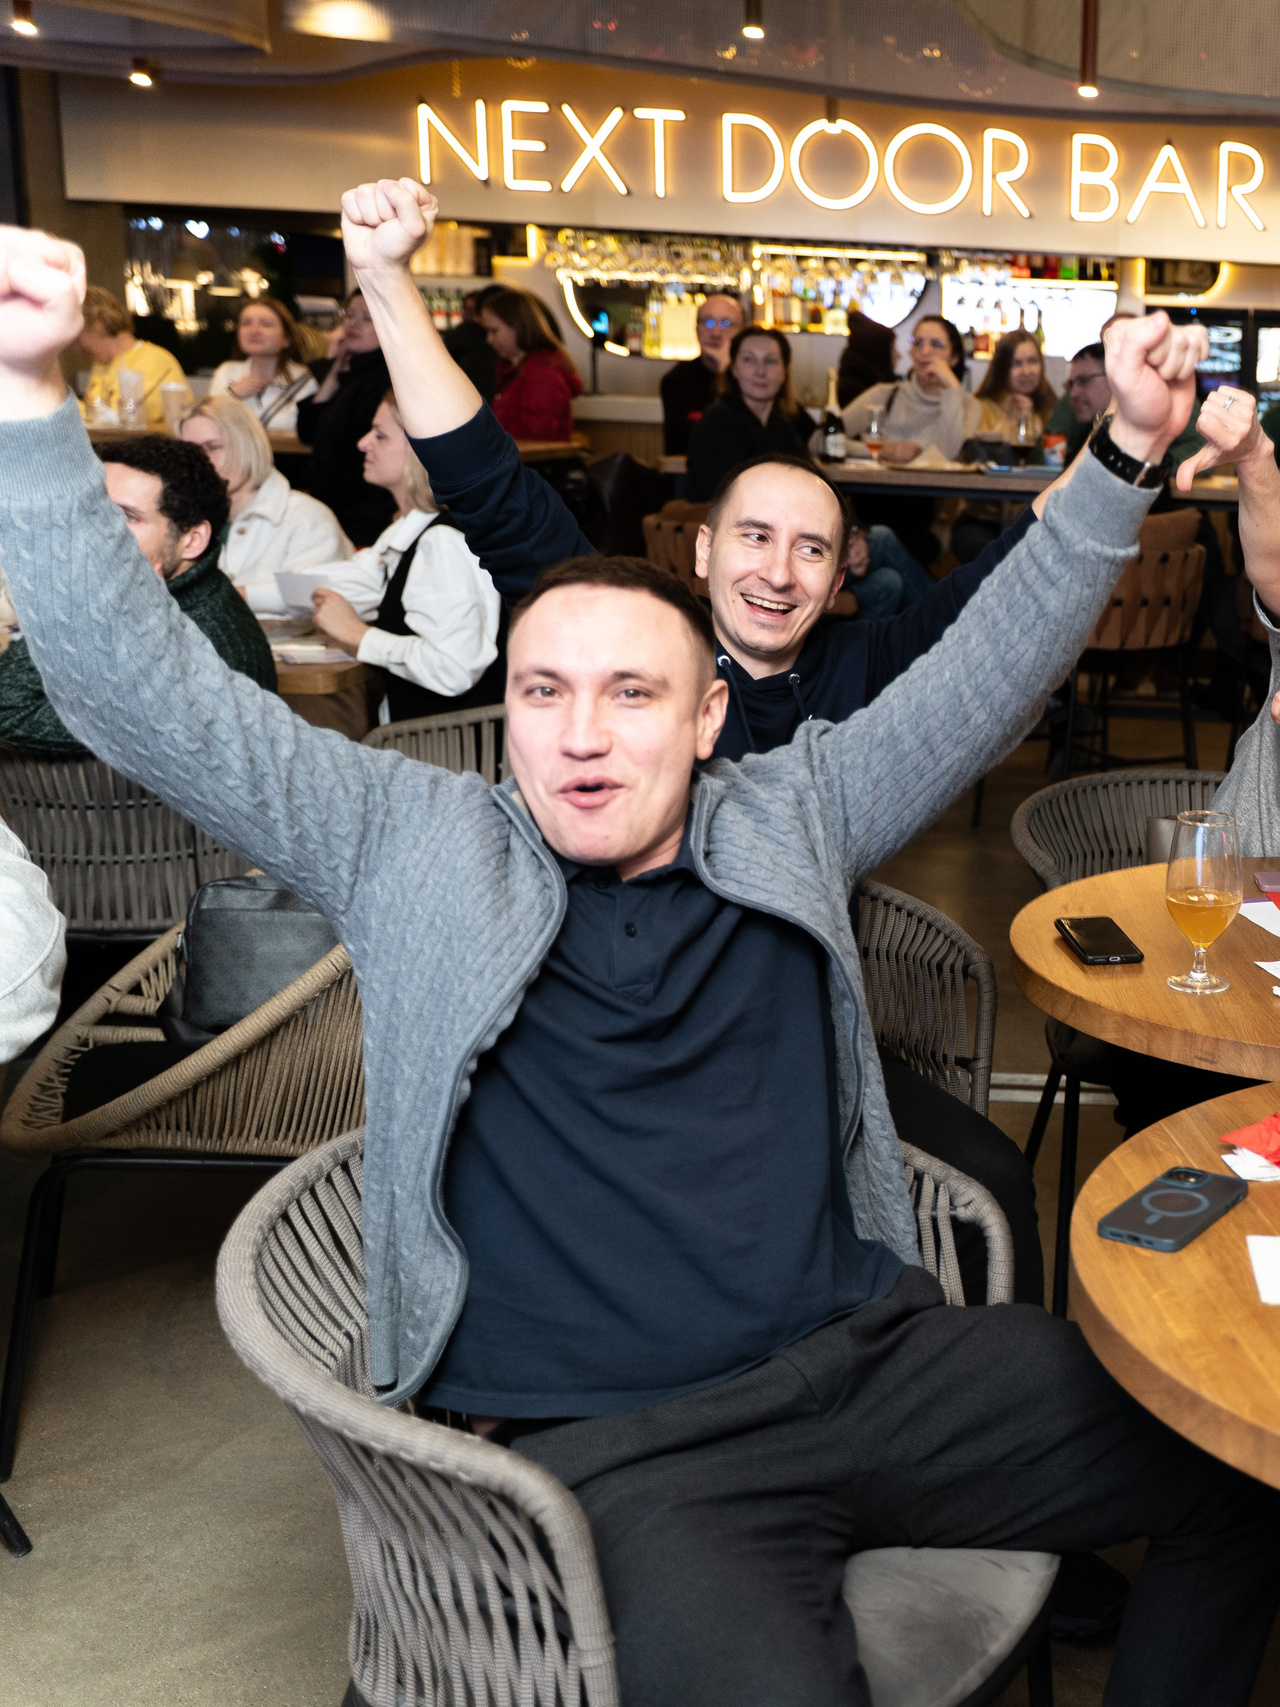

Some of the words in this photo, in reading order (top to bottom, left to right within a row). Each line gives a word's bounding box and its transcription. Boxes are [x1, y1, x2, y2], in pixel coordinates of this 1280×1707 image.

[417, 100, 686, 198] NEXT
[722, 113, 1030, 218] DOOR
[1070, 133, 1265, 231] BAR
